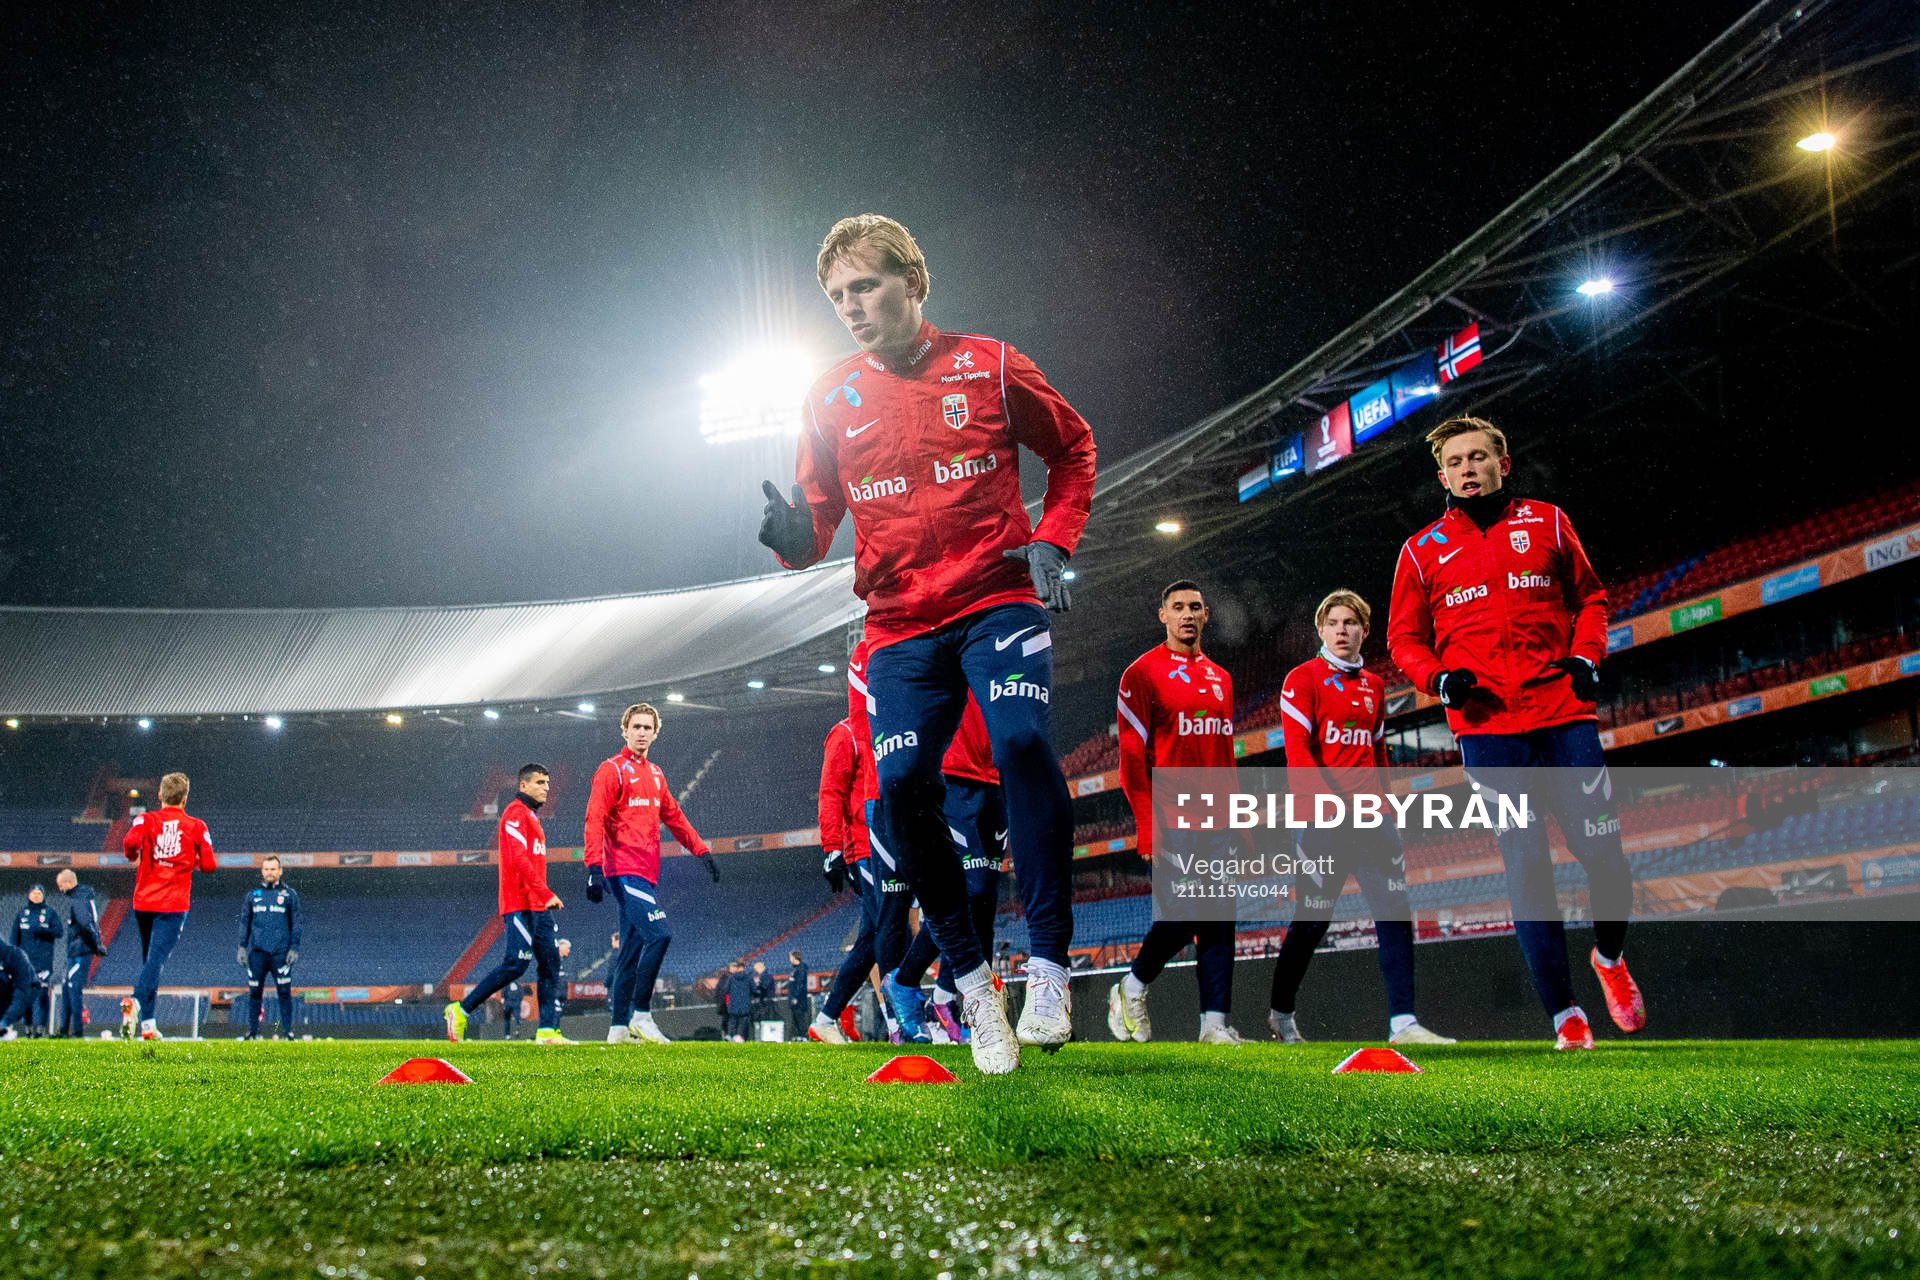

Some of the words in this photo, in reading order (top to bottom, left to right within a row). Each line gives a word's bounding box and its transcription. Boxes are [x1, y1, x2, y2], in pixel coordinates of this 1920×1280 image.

[865, 356, 885, 372] ama
[941, 373, 963, 383] Norsk
[963, 370, 990, 382] Tipping
[1353, 397, 1391, 430] UEFA
[1273, 446, 1298, 471] FIFA
[1868, 544, 1901, 568] ING
[1584, 817, 1620, 838] bam
[963, 857, 990, 870] ama
